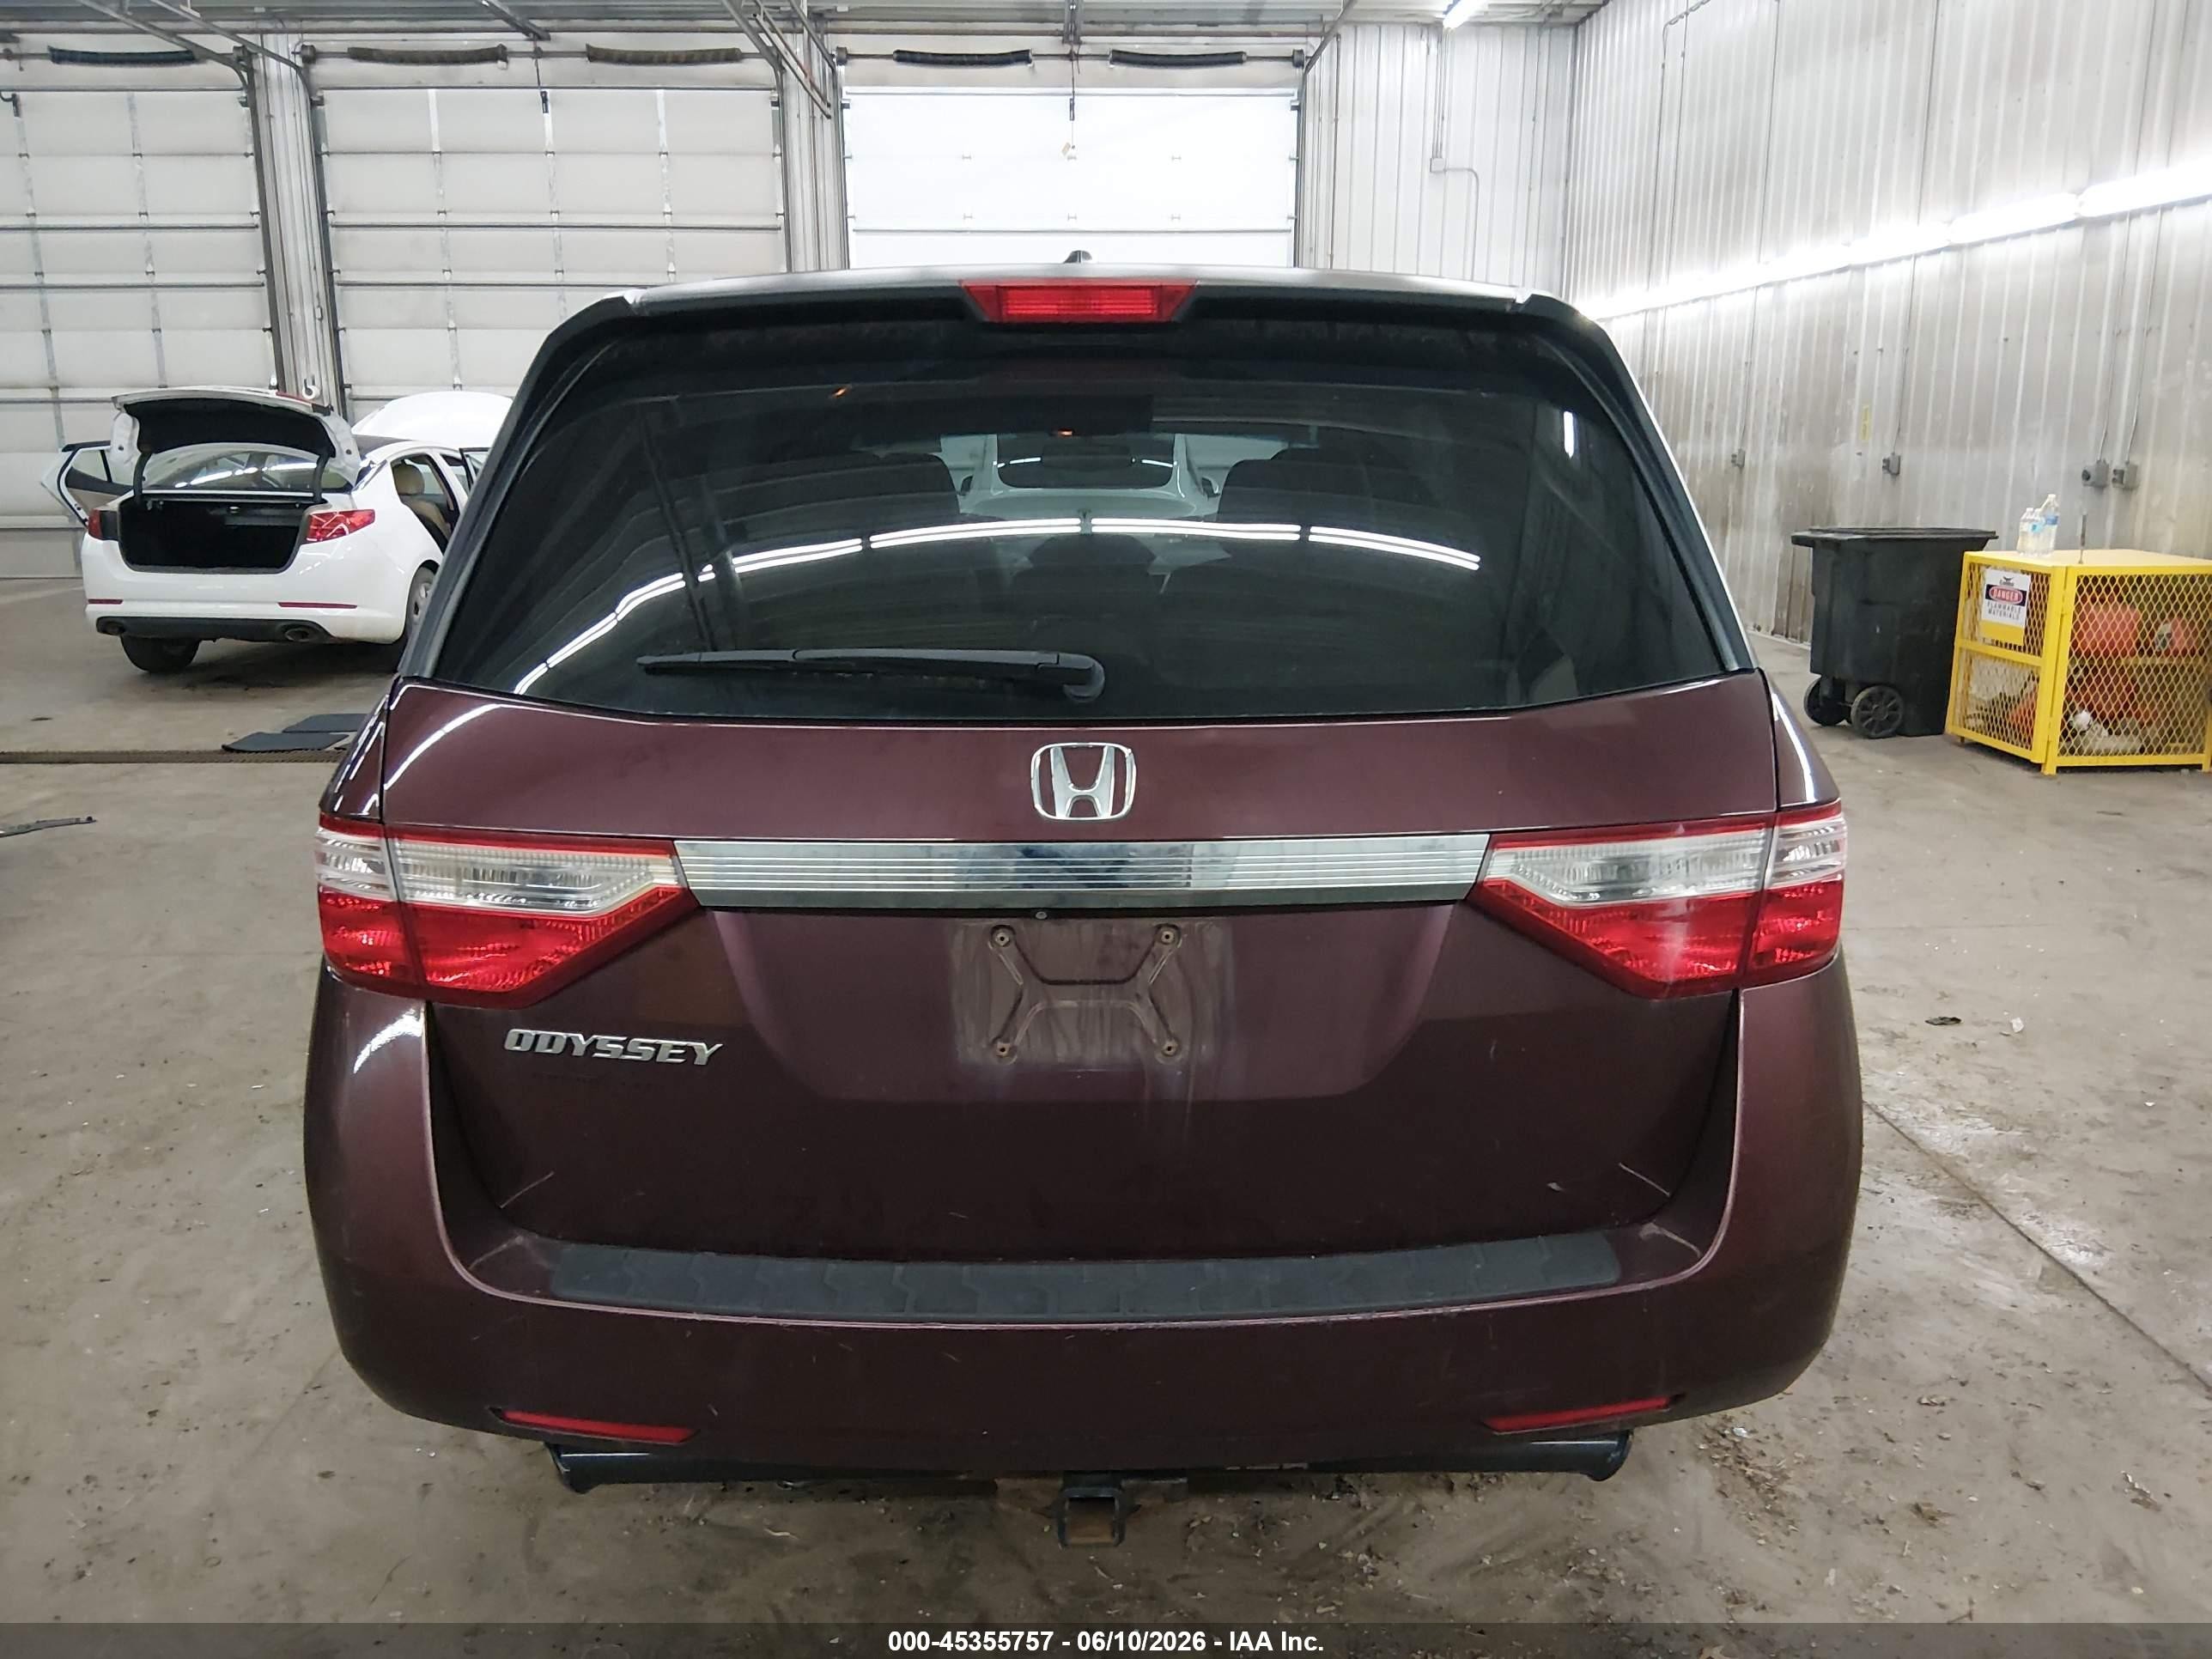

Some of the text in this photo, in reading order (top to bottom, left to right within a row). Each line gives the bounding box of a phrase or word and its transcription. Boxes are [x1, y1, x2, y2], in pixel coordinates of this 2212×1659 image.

[1992, 588, 2019, 601] DANGER
[1987, 600, 2021, 614] FLAMMABLE
[1988, 608, 2020, 620] MATERIALS
[504, 1028, 723, 1066] ODYSSEY
